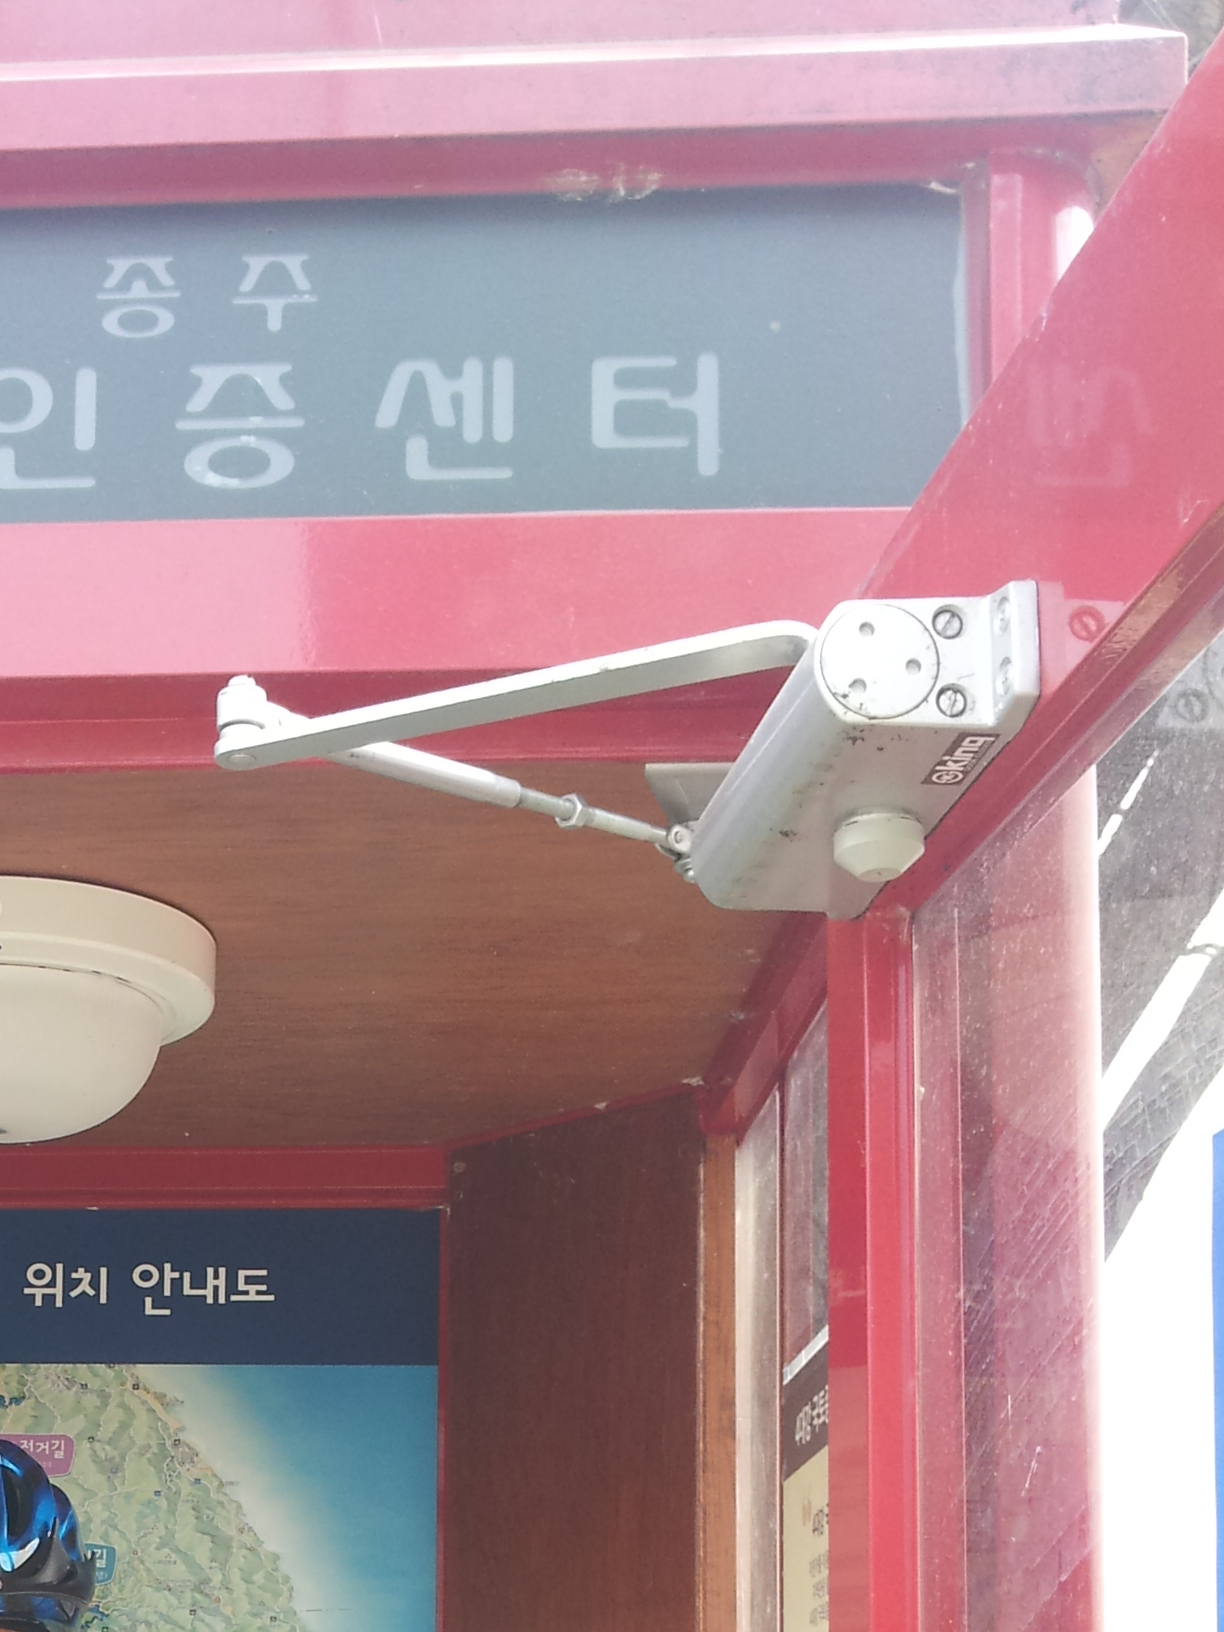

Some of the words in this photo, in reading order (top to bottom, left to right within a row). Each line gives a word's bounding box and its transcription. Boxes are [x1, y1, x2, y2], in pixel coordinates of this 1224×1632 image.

[95, 252, 318, 340] 종주
[22, 1262, 110, 1308] 위치
[130, 1262, 277, 1316] 안내도
